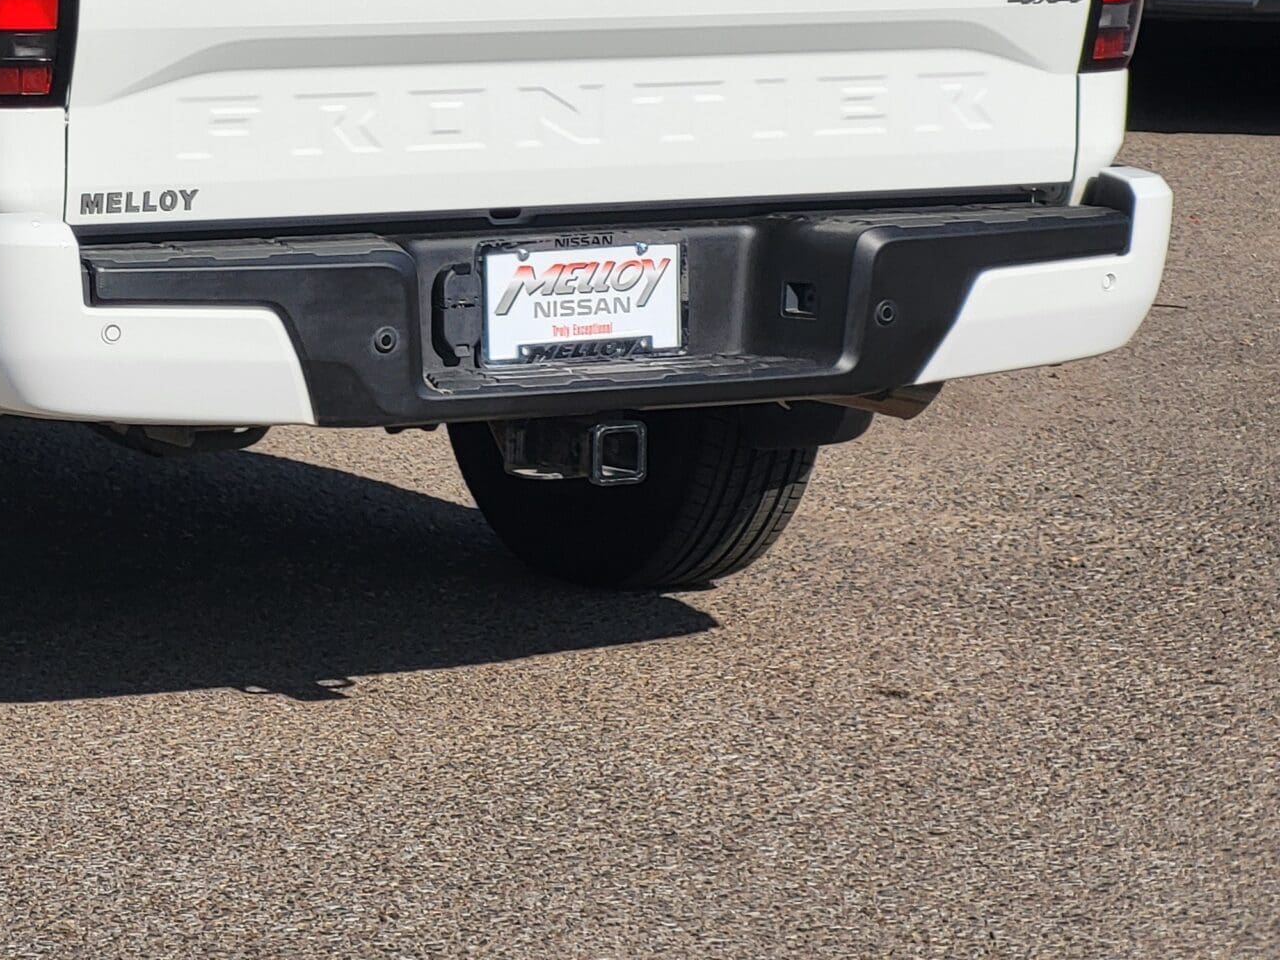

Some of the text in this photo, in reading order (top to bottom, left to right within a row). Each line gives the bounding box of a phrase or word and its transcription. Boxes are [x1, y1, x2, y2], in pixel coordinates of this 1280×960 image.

[175, 72, 993, 161] FRONTIER
[80, 189, 199, 215] MELLOY
[554, 234, 613, 248] NISSAN
[533, 296, 631, 319] NISSAN
[552, 320, 613, 338] Truly Exceptional
[526, 339, 642, 364] MELLOY
